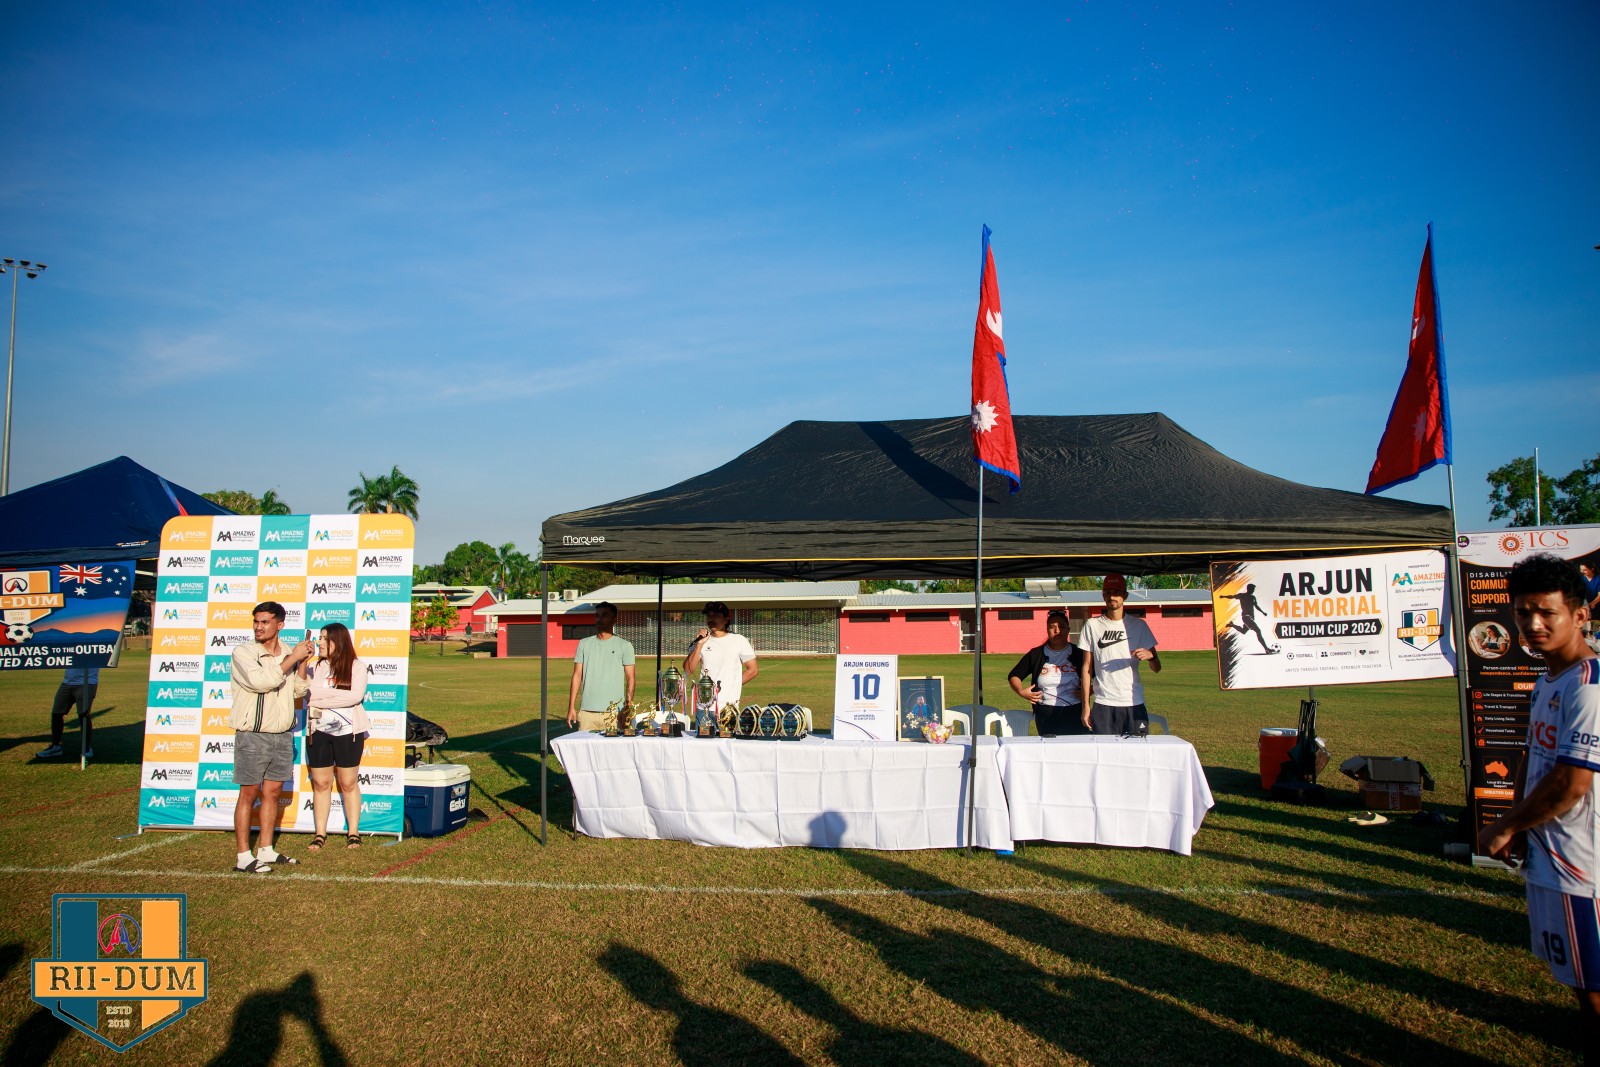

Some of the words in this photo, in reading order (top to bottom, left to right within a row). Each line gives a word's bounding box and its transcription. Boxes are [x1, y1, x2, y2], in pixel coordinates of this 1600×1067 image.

[563, 535, 605, 545] Marquee
[1524, 531, 1569, 547] TCS
[1279, 568, 1372, 596] ARJUN
[0, 596, 58, 607] I-DUM
[1273, 595, 1381, 618] MEMORIAL
[1102, 630, 1125, 640] NIKE
[1281, 624, 1325, 636] RII-DUM
[1328, 624, 1349, 635] CUP
[1351, 622, 1377, 634] 2026
[1400, 626, 1440, 637] RII-DUM
[0, 658, 21, 667] TED
[24, 657, 42, 667] AS
[47, 656, 73, 666] ONE
[852, 674, 880, 700] 10
[1571, 732, 1600, 747] 202
[1542, 930, 1567, 966] 19
